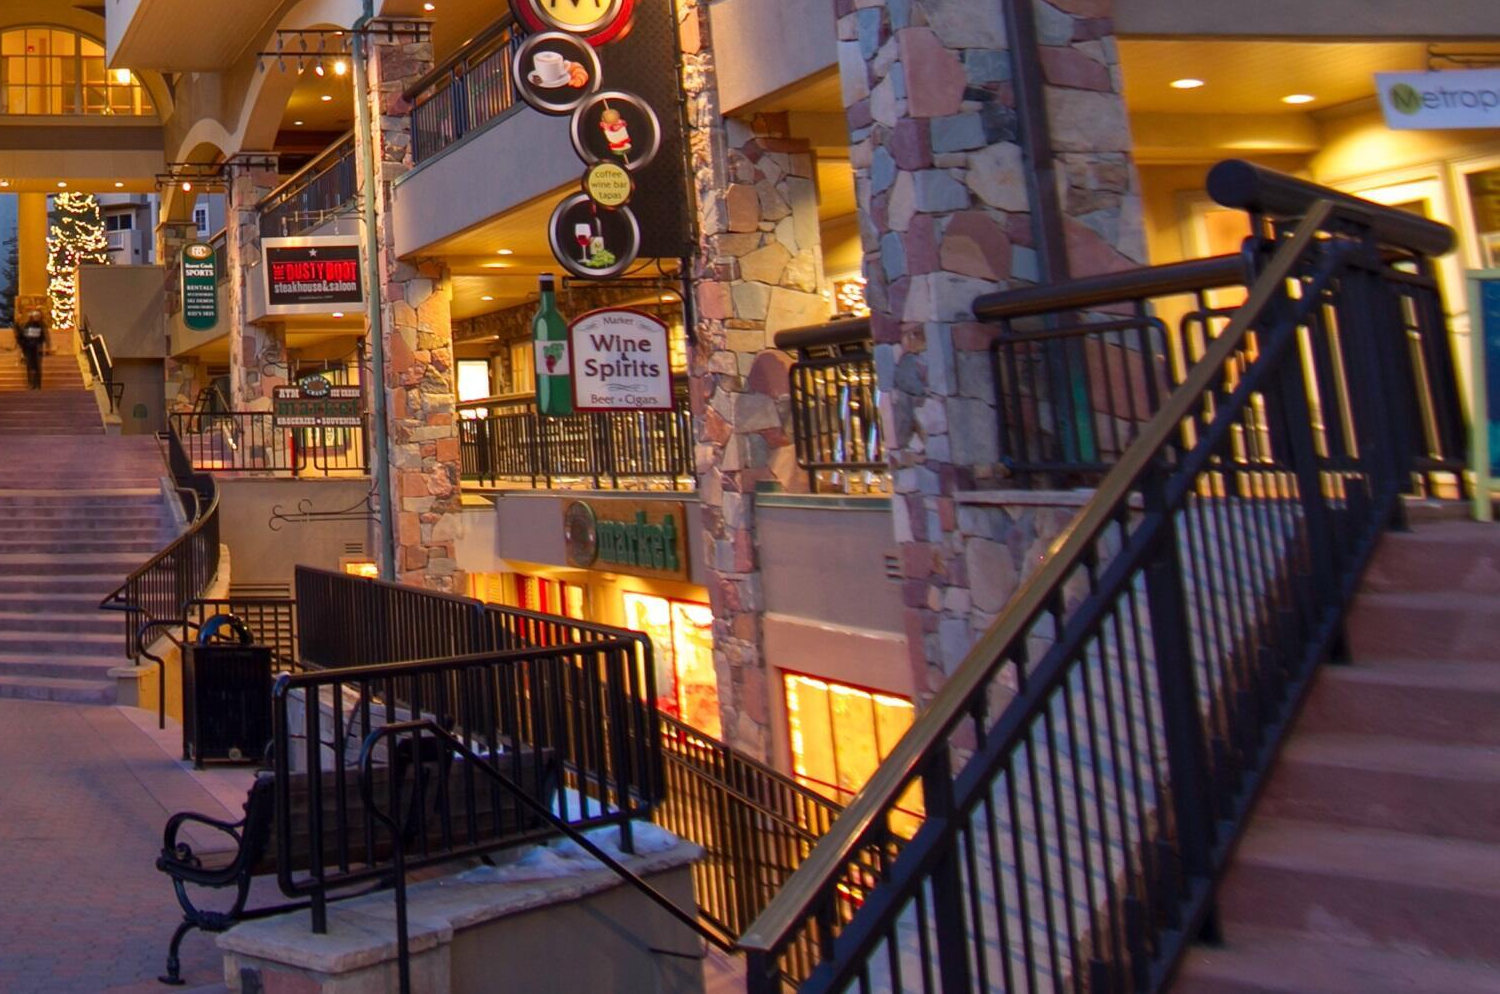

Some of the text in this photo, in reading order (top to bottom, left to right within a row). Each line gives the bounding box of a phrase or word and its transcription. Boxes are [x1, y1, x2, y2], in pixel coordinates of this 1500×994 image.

[595, 170, 622, 179] coffee
[591, 179, 627, 189] wine bar
[598, 192, 622, 200] tapas
[273, 261, 357, 281] THE DUSTY BOOT
[274, 280, 357, 293] steakhouse&saloon
[603, 316, 634, 325] Market
[590, 333, 652, 352] Wine
[621, 352, 629, 361] &
[585, 358, 660, 381] Spirits
[279, 389, 300, 398] ATM
[278, 397, 357, 415] market
[591, 394, 658, 407] Beer Cigars
[596, 510, 680, 572] market
